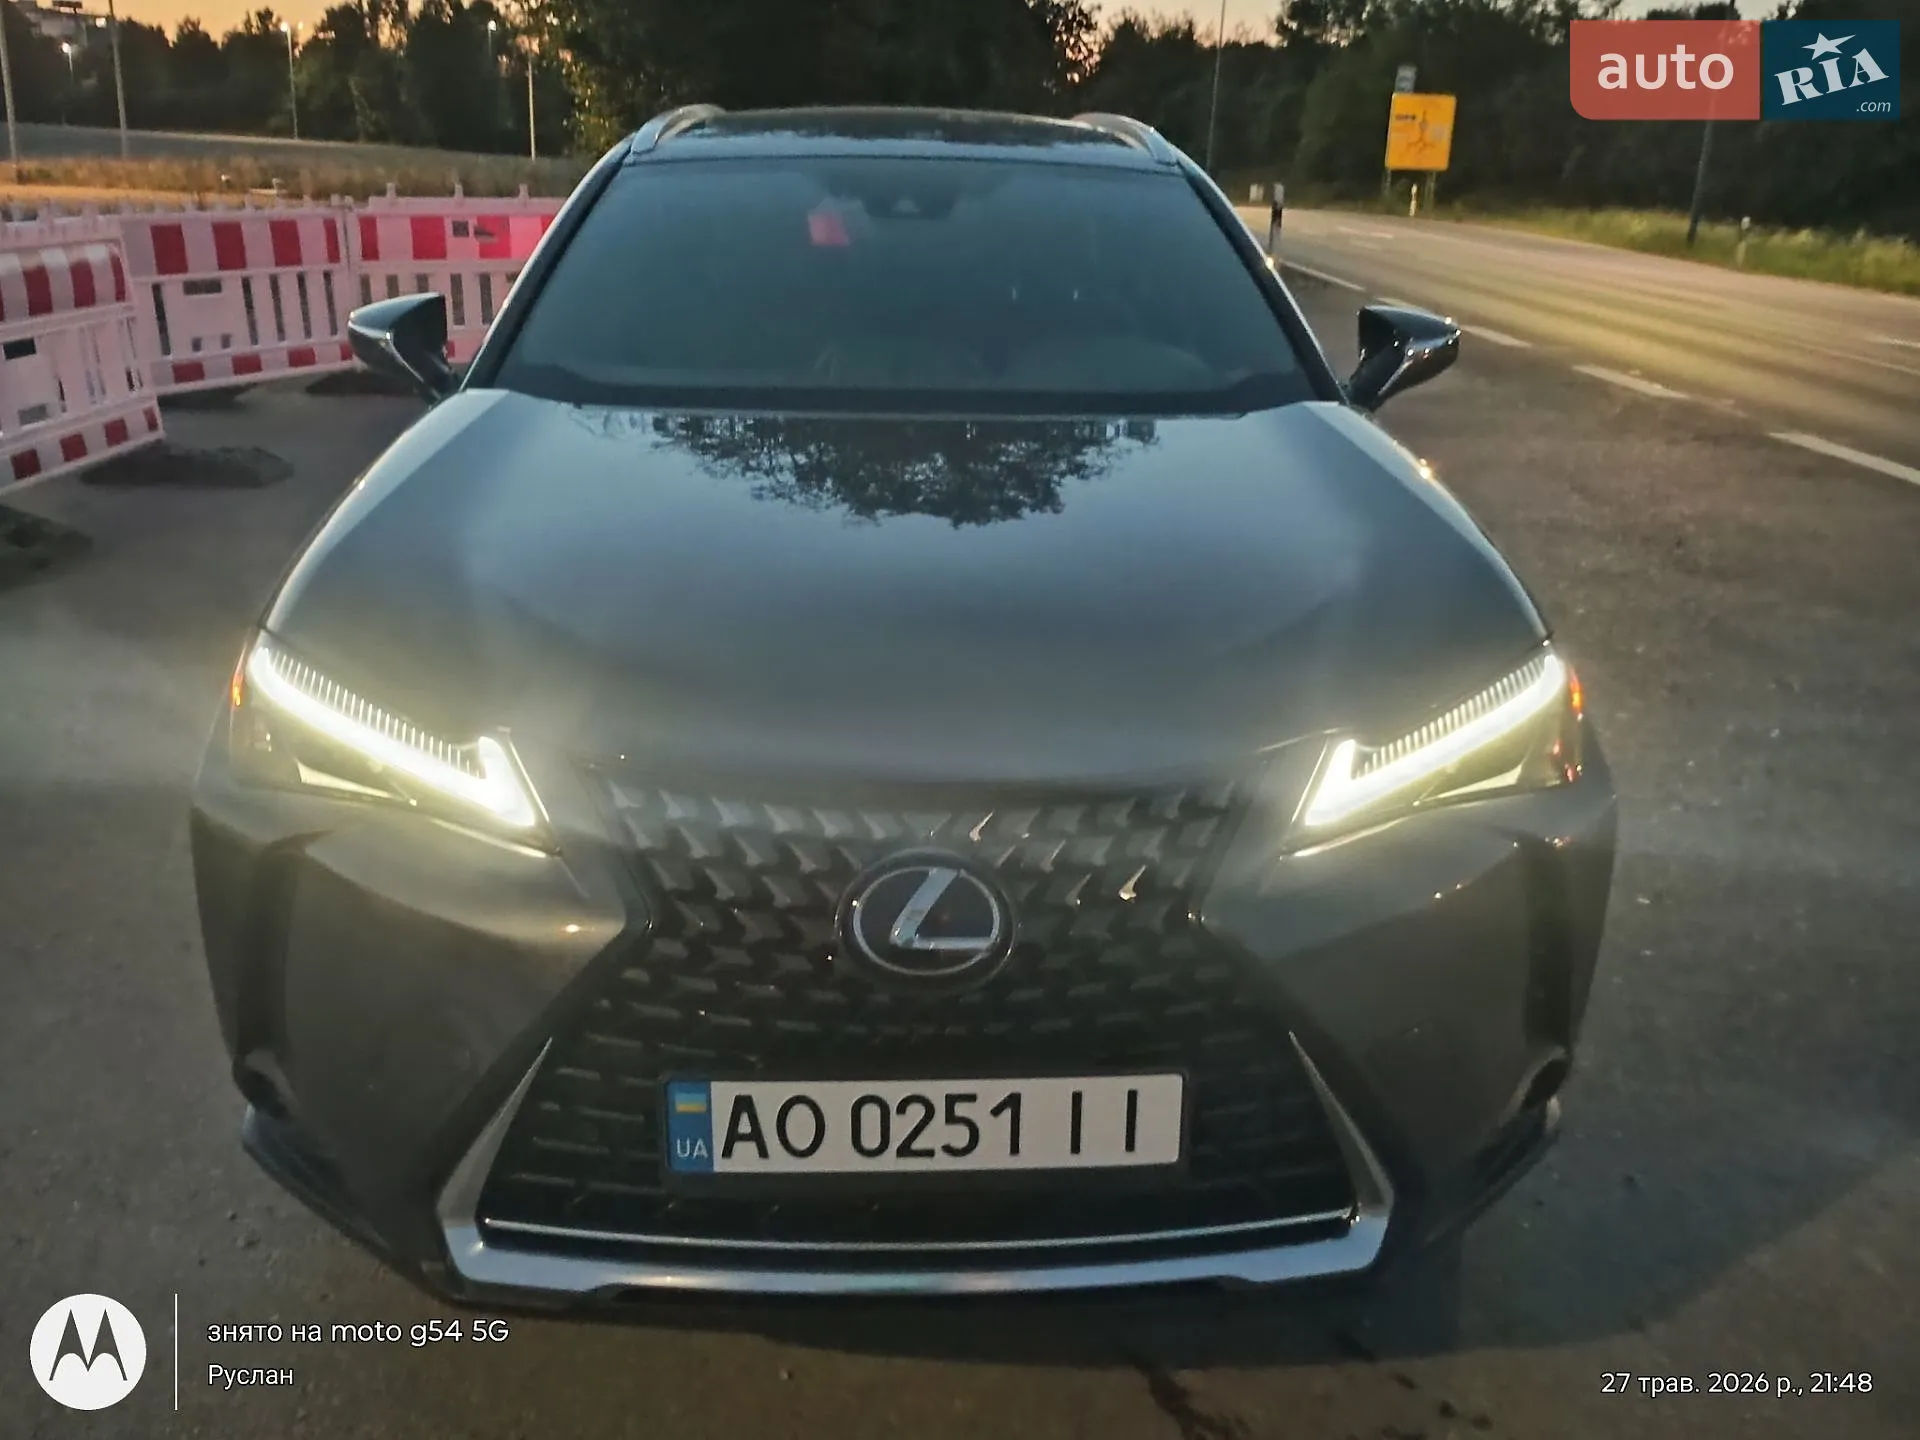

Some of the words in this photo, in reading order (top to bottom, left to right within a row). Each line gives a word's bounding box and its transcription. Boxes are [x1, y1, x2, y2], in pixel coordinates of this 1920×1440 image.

[721, 1094, 826, 1158] AO
[851, 1092, 1021, 1158] 0251
[676, 1140, 708, 1158] UA
